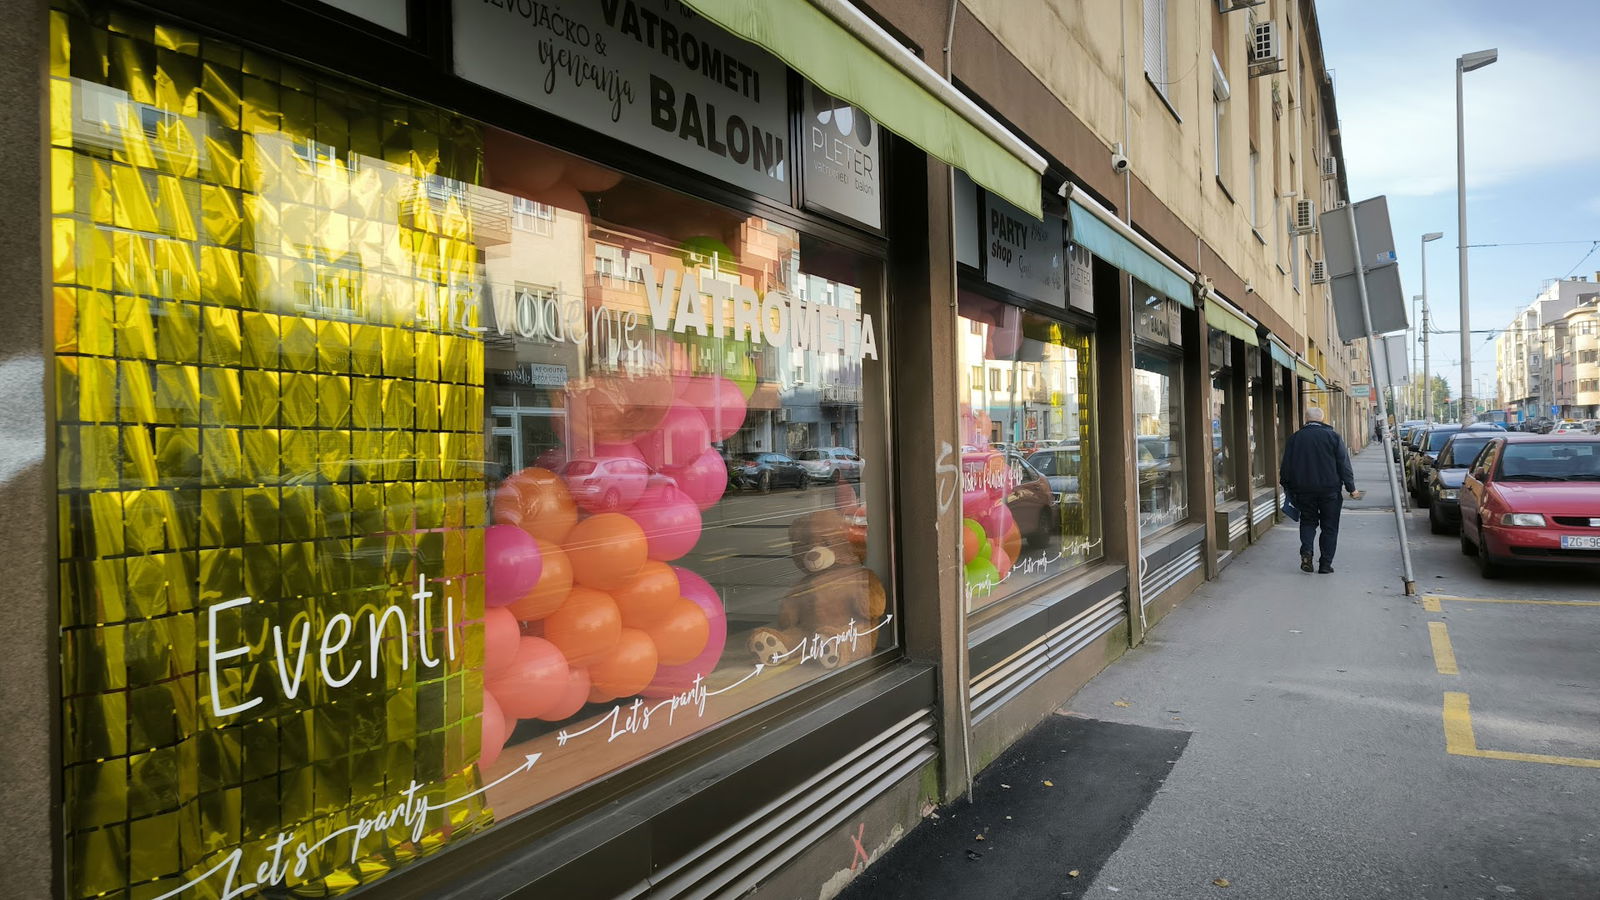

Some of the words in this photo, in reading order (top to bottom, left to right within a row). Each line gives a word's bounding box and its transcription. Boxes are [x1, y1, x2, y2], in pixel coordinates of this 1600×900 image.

[595, 33, 607, 56] &
[601, 0, 760, 104] VATROMETI
[538, 38, 635, 122] vjenčanja
[650, 74, 784, 182] BALONI
[812, 126, 873, 180] PLETER
[991, 208, 1027, 250] PARTY
[991, 240, 1013, 268] shop
[641, 262, 879, 361] VATROMETA
[1570, 537, 1583, 547] ZG
[209, 573, 455, 717] Eventi
[800, 632, 825, 665] Let's
[834, 618, 859, 652] party
[607, 698, 651, 743] Let's
[668, 673, 710, 726] party
[205, 832, 308, 900] Let's
[350, 780, 431, 864] party
